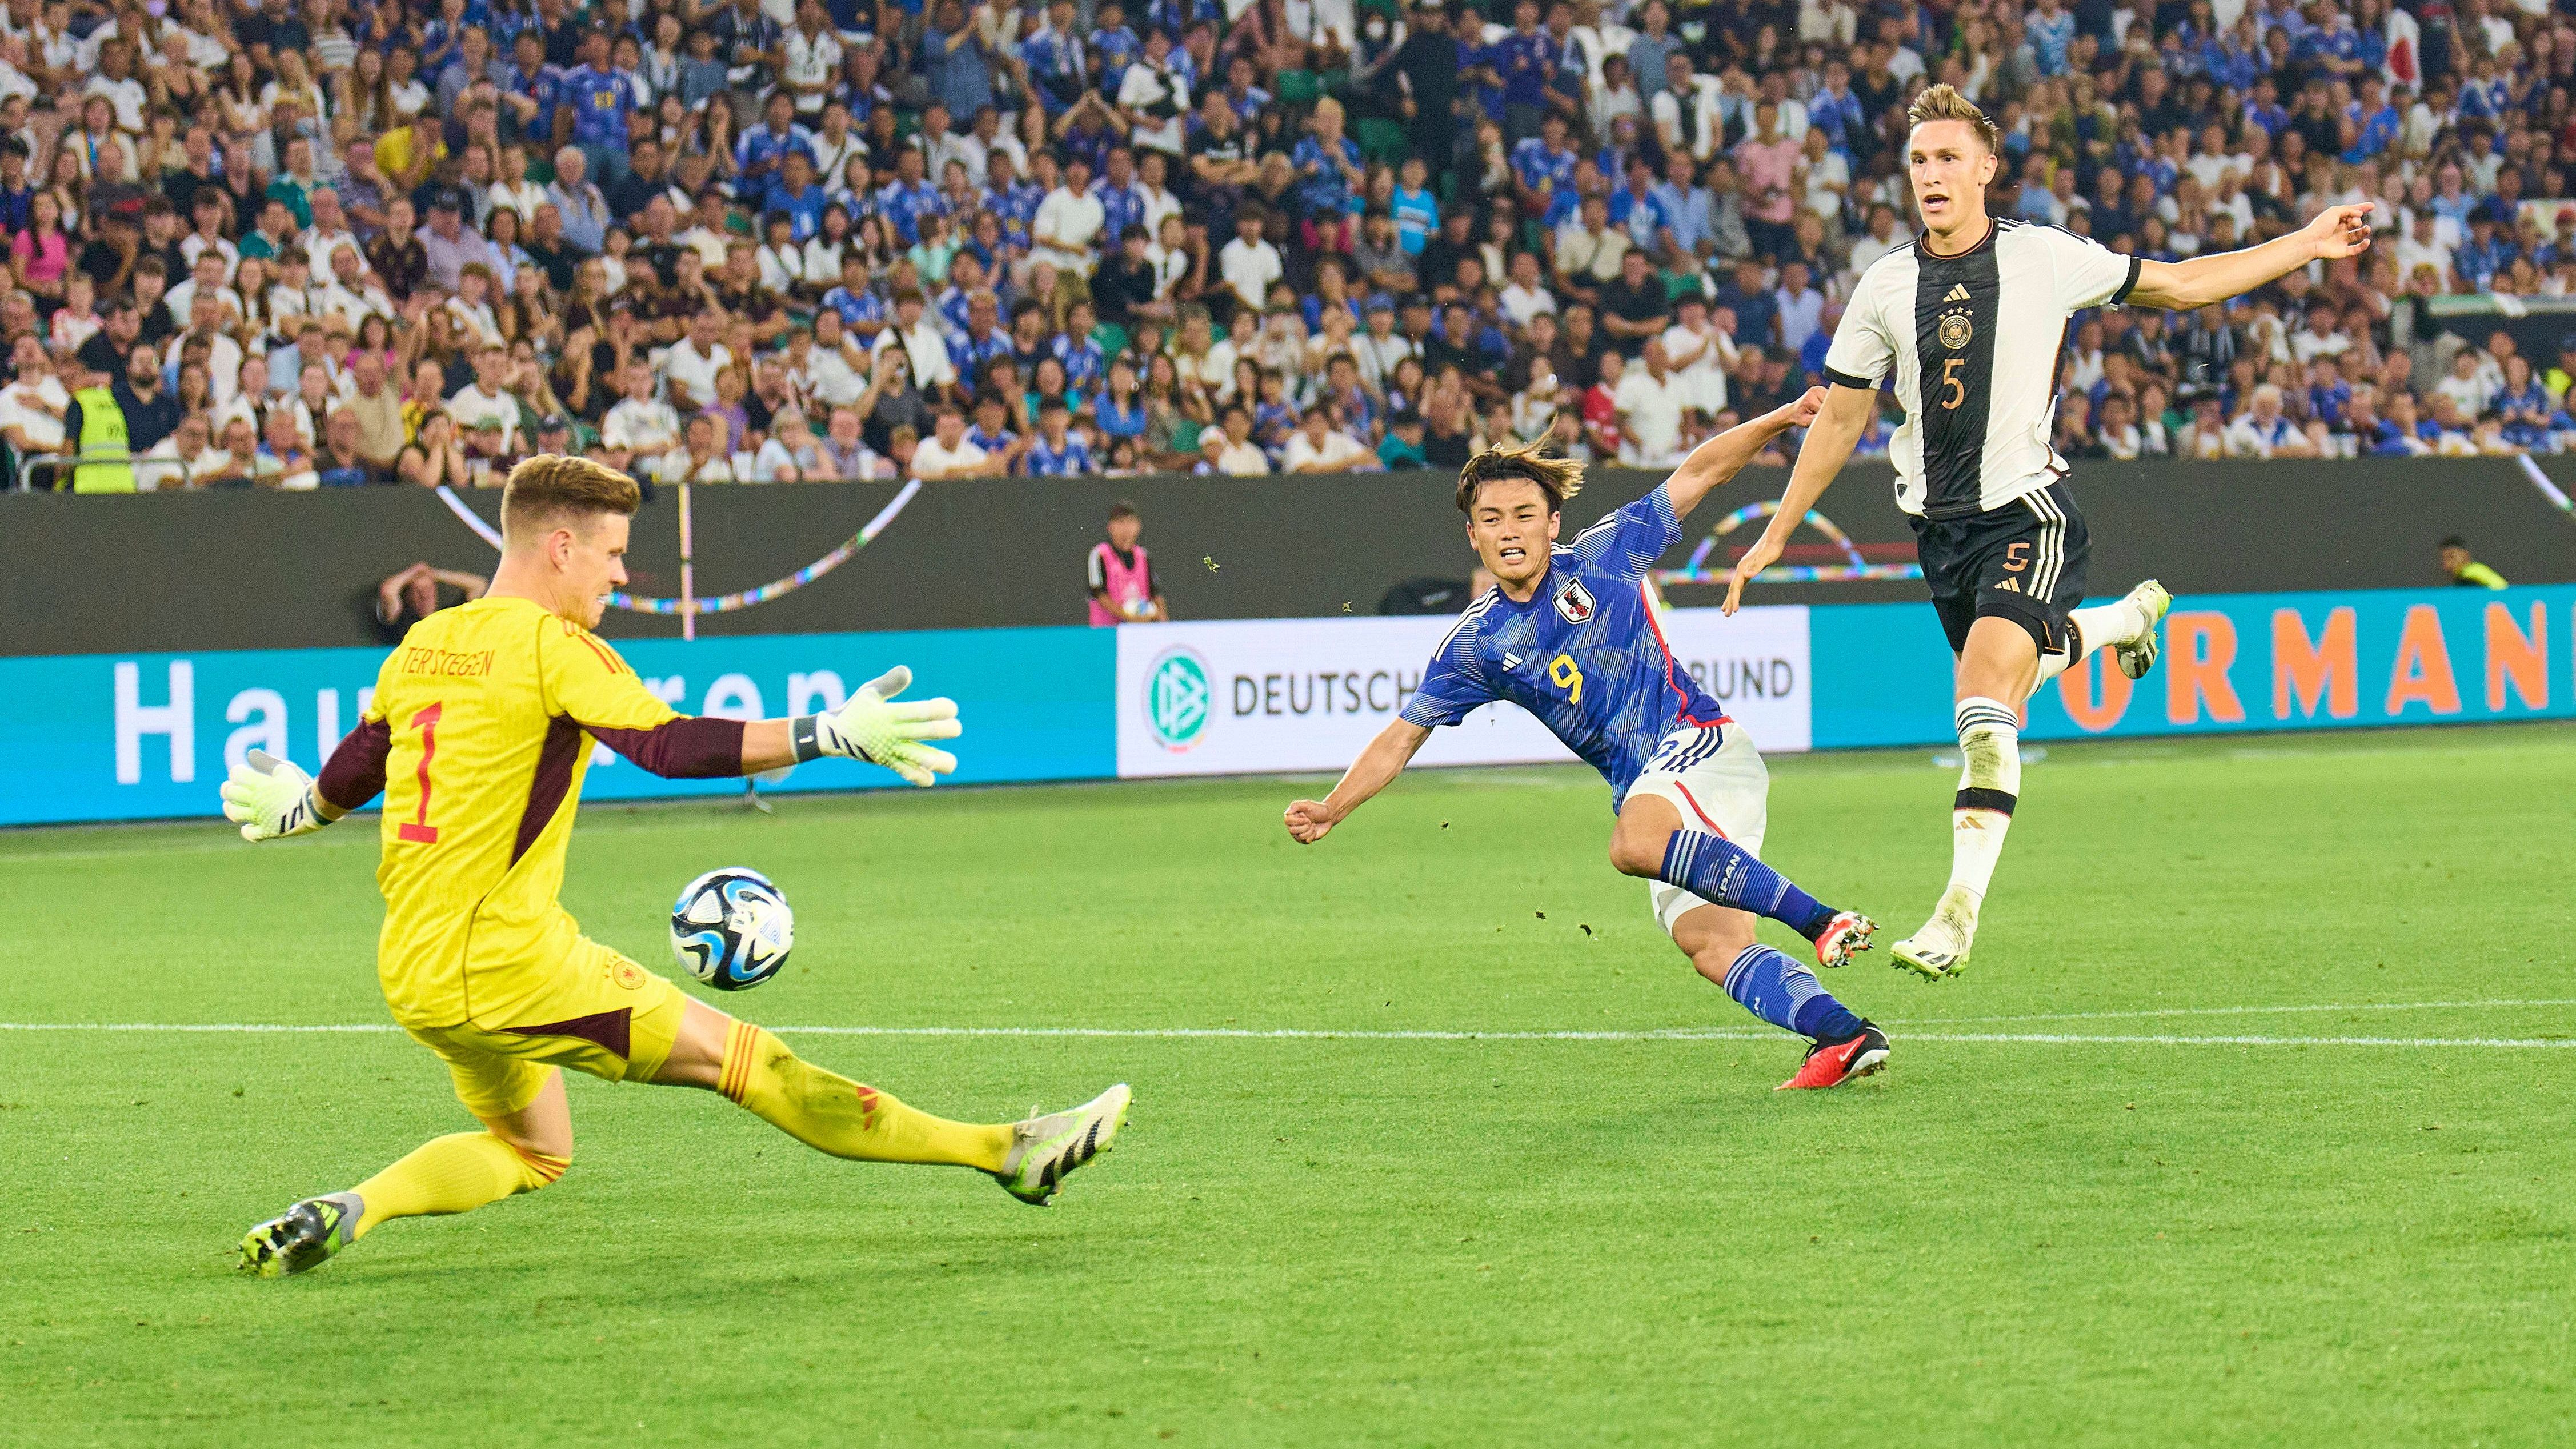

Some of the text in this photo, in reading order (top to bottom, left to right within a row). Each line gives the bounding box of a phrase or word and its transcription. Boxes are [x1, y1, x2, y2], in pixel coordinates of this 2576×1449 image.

[1942, 358, 1965, 410] 5
[2002, 542, 2030, 571] 5
[402, 647, 495, 676] TER STEGEN
[1549, 655, 1583, 705] 9
[398, 701, 442, 844] 1
